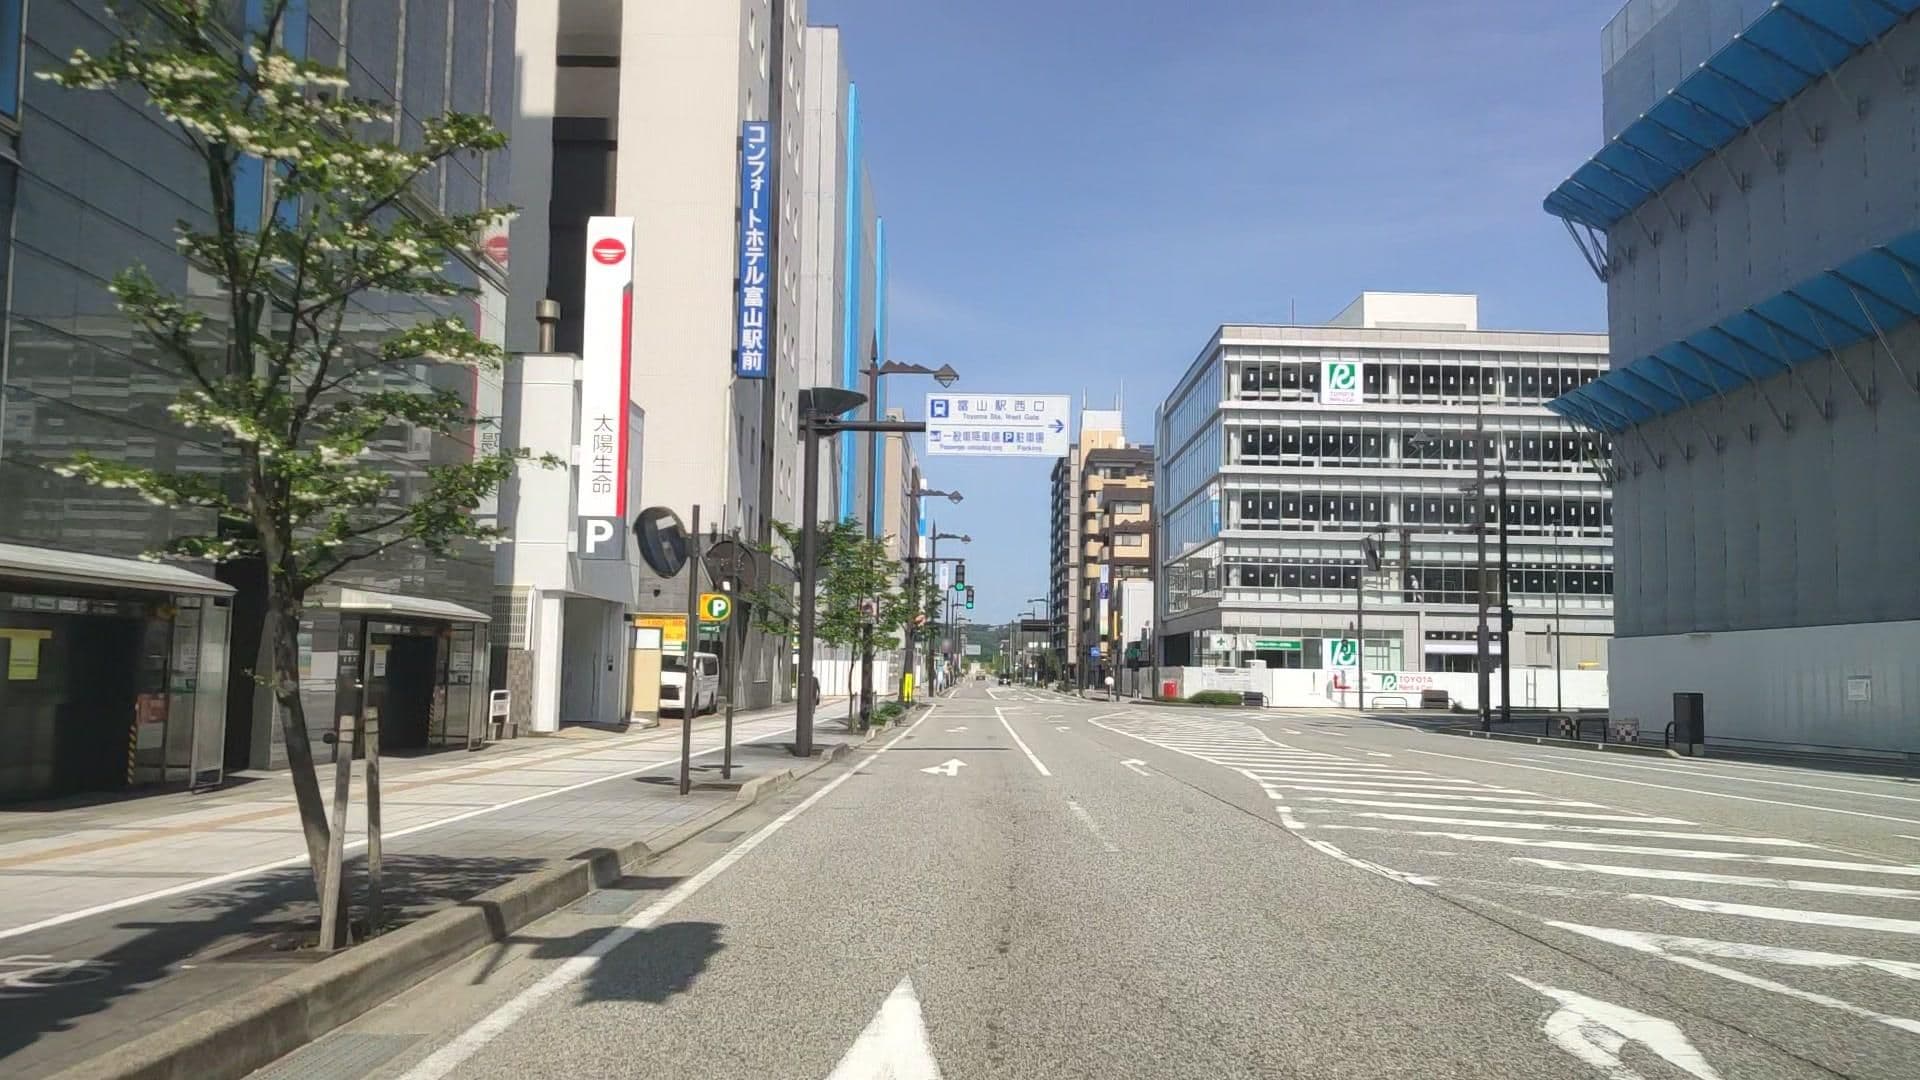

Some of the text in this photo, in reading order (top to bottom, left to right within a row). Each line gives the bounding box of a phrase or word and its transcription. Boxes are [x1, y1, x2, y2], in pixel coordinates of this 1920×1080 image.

[742, 125, 766, 371] コンフォートホテル富山駅前
[957, 399, 1045, 412] 富山駅西口
[592, 413, 613, 494] 太陽生命
[585, 519, 614, 554] P
[712, 599, 726, 616] P
[1399, 675, 1433, 683] TOYOTA
